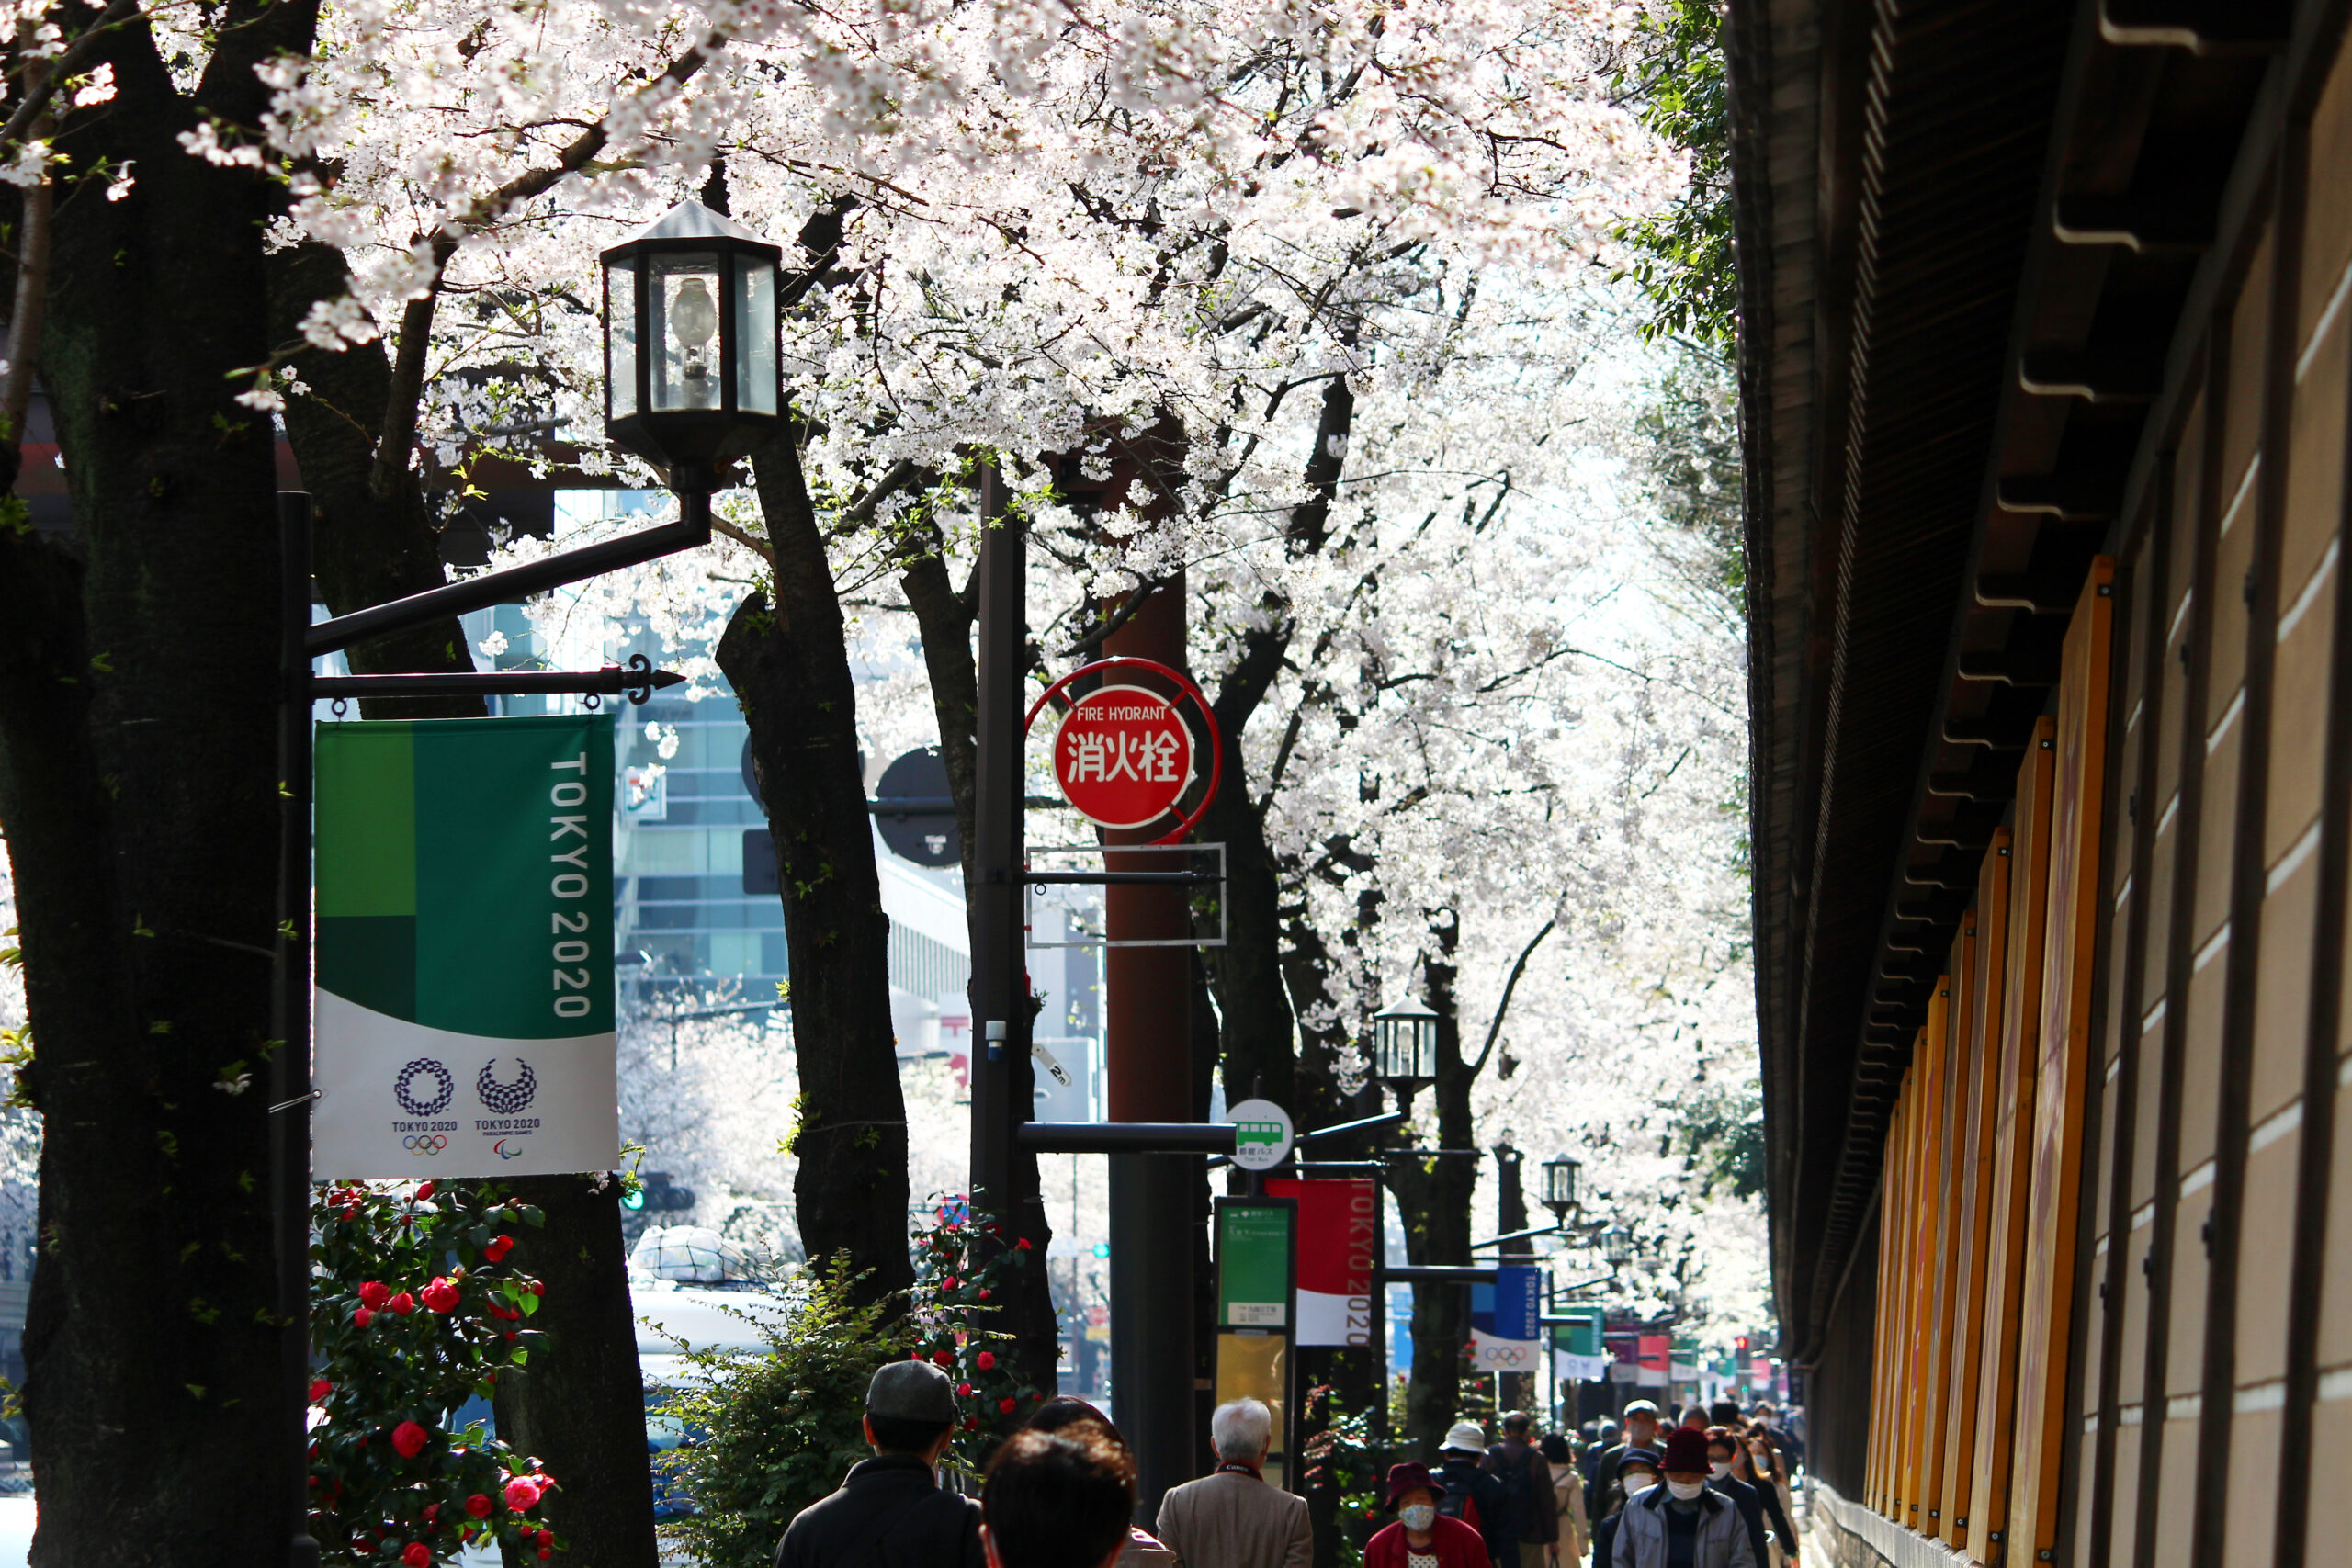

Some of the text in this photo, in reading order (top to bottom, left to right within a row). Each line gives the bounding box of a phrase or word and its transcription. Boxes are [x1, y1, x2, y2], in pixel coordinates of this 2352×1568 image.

[1077, 705, 1167, 721] FIRE HYDRANT
[1067, 730, 1180, 783] 消火栓
[550, 751, 591, 1018] TOKYO 2020
[1050, 1066, 1066, 1085] 2m
[392, 1121, 457, 1133] TOKYO 2020
[475, 1118, 540, 1131] TOKYO 2020
[1346, 1179, 1375, 1348] TOKYO 2020
[1525, 1275, 1536, 1337] TOKYO 2020
